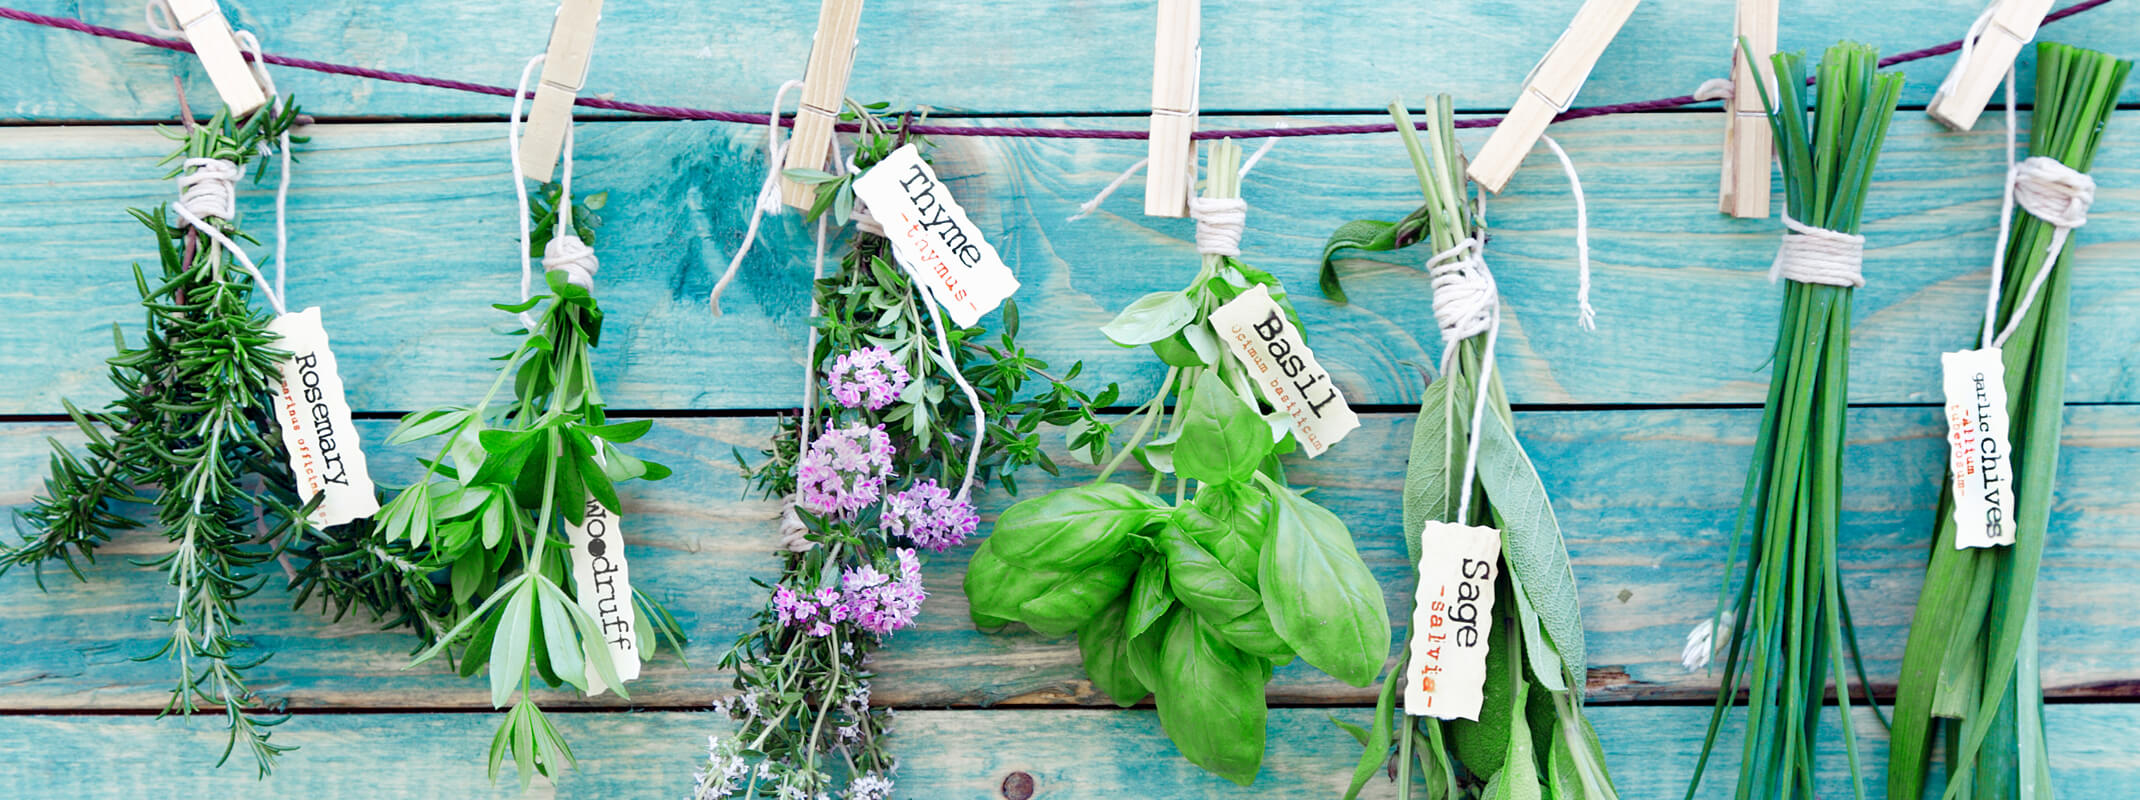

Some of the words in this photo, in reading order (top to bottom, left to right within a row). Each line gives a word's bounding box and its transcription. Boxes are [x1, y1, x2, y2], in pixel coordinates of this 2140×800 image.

[899, 164, 981, 268] Thyme
[901, 212, 977, 311] -thymus-
[1232, 325, 1269, 374] Ocimum
[1270, 378, 1323, 450] basilicum
[1253, 309, 1336, 419] Basil
[1971, 372, 1990, 432] garlic
[295, 351, 349, 487] Rosemary
[1421, 585, 1447, 708] -salvia-
[1448, 558, 1490, 648] Sage
